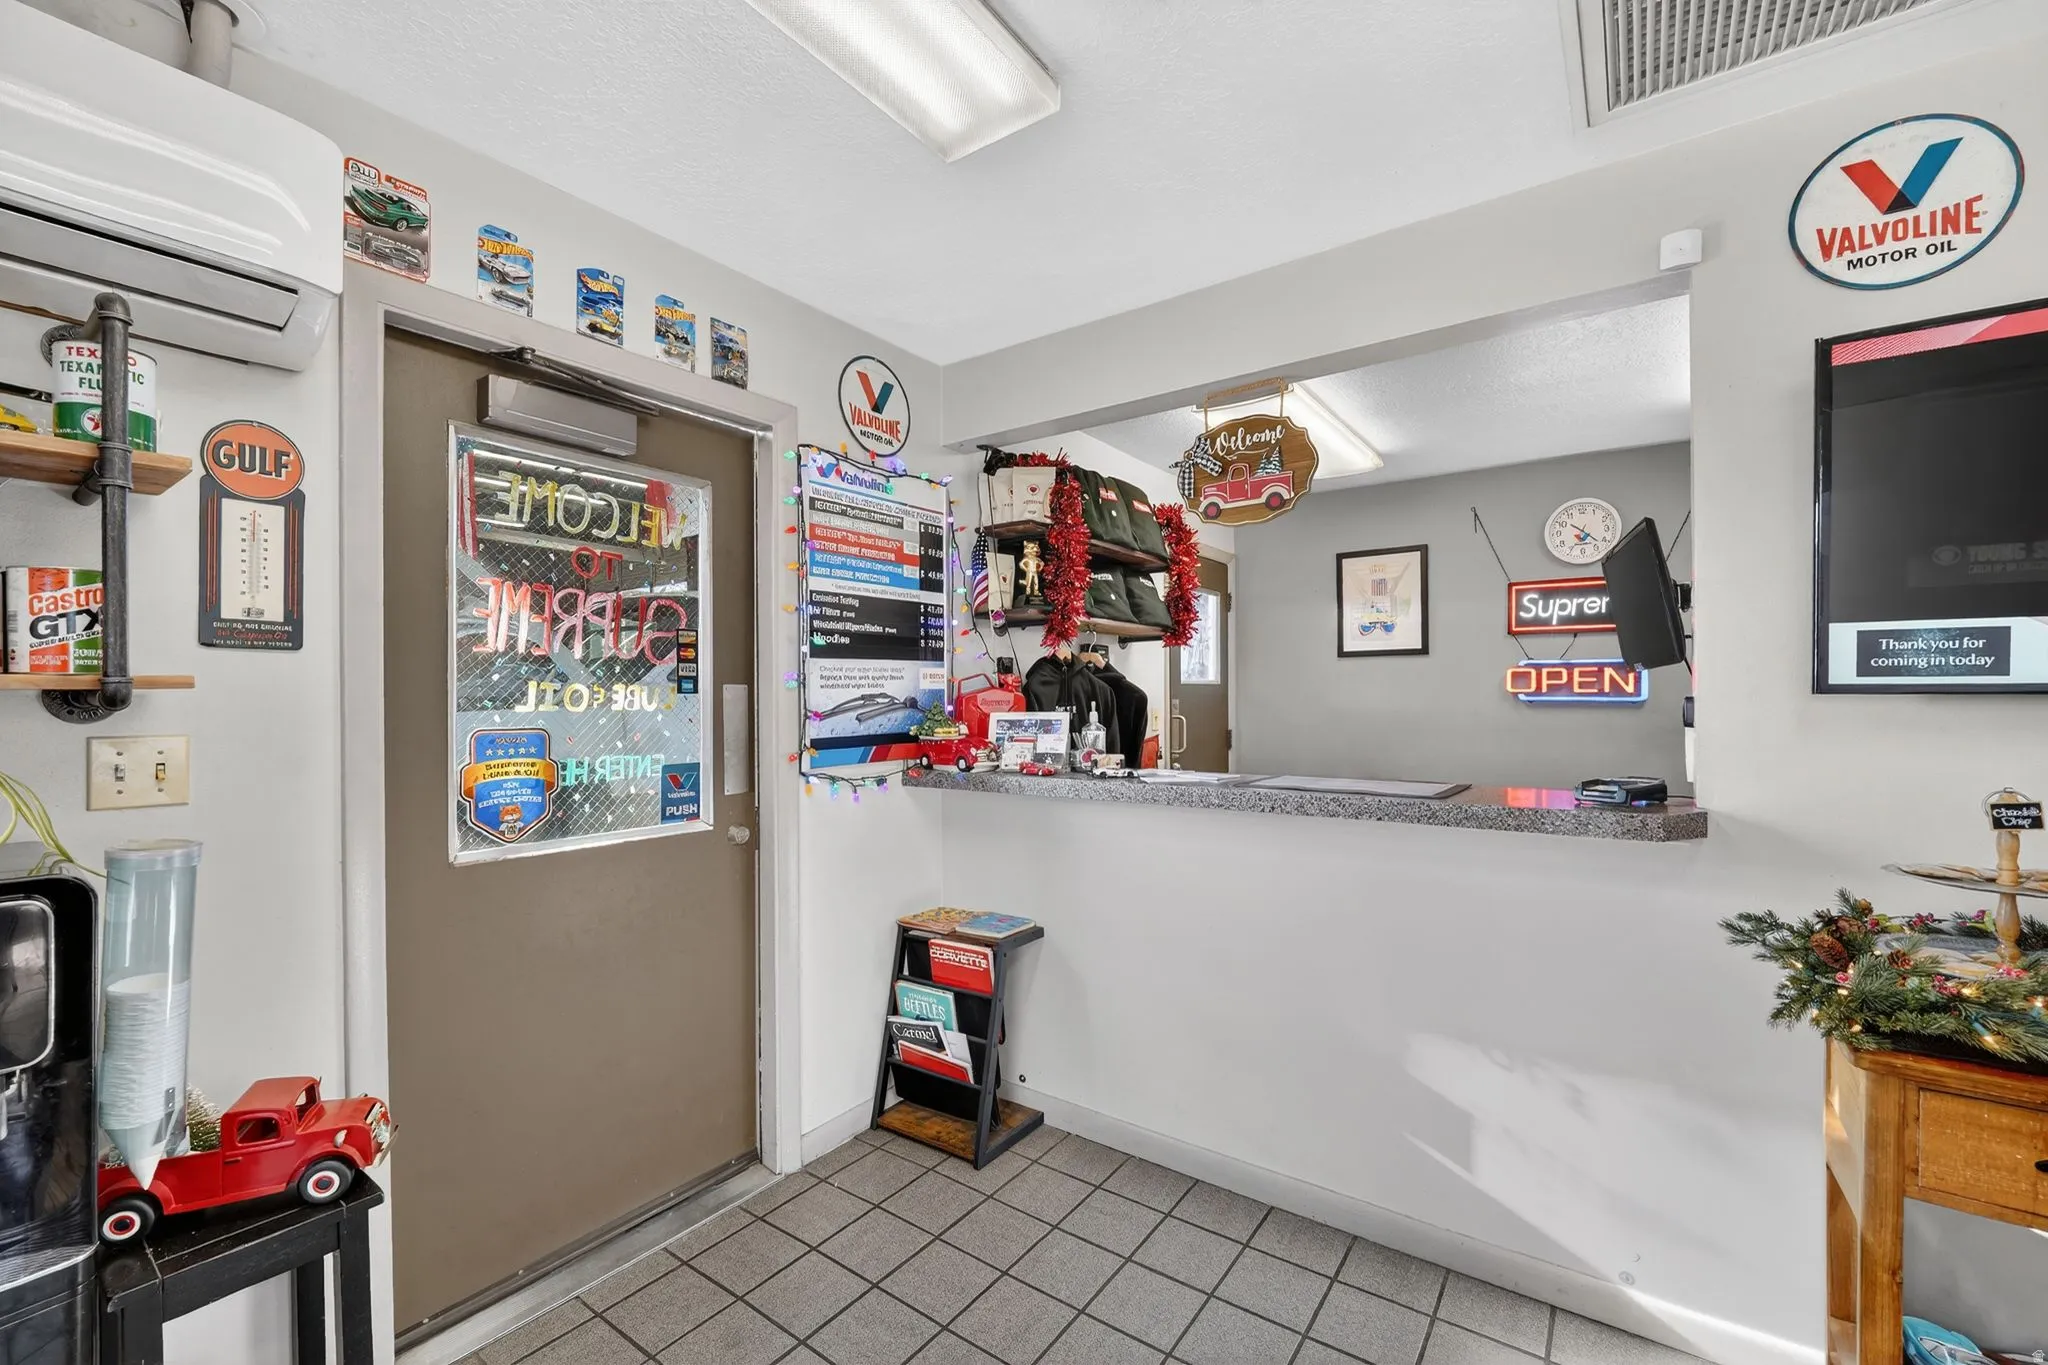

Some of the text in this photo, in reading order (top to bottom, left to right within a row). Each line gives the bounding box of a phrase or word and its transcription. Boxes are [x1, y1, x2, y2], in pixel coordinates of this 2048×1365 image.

[1816, 194, 1984, 262] VALVOLINE
[1847, 240, 1957, 270] MOTOR OIL
[849, 401, 901, 443] VALVOLINE
[860, 429, 883, 444] MOTOR
[1208, 425, 1285, 456] Welcome
[211, 439, 293, 481] GULF
[29, 587, 104, 616] Castro
[29, 608, 103, 640] GTX
[1879, 637, 1986, 652] Thank you for
[1871, 654, 1995, 668] coming in today
[1507, 667, 1635, 693] OPEN
[665, 803, 698, 817] PUSH
[930, 950, 989, 969] CORVETTE
[904, 997, 946, 1021] BEETLES
